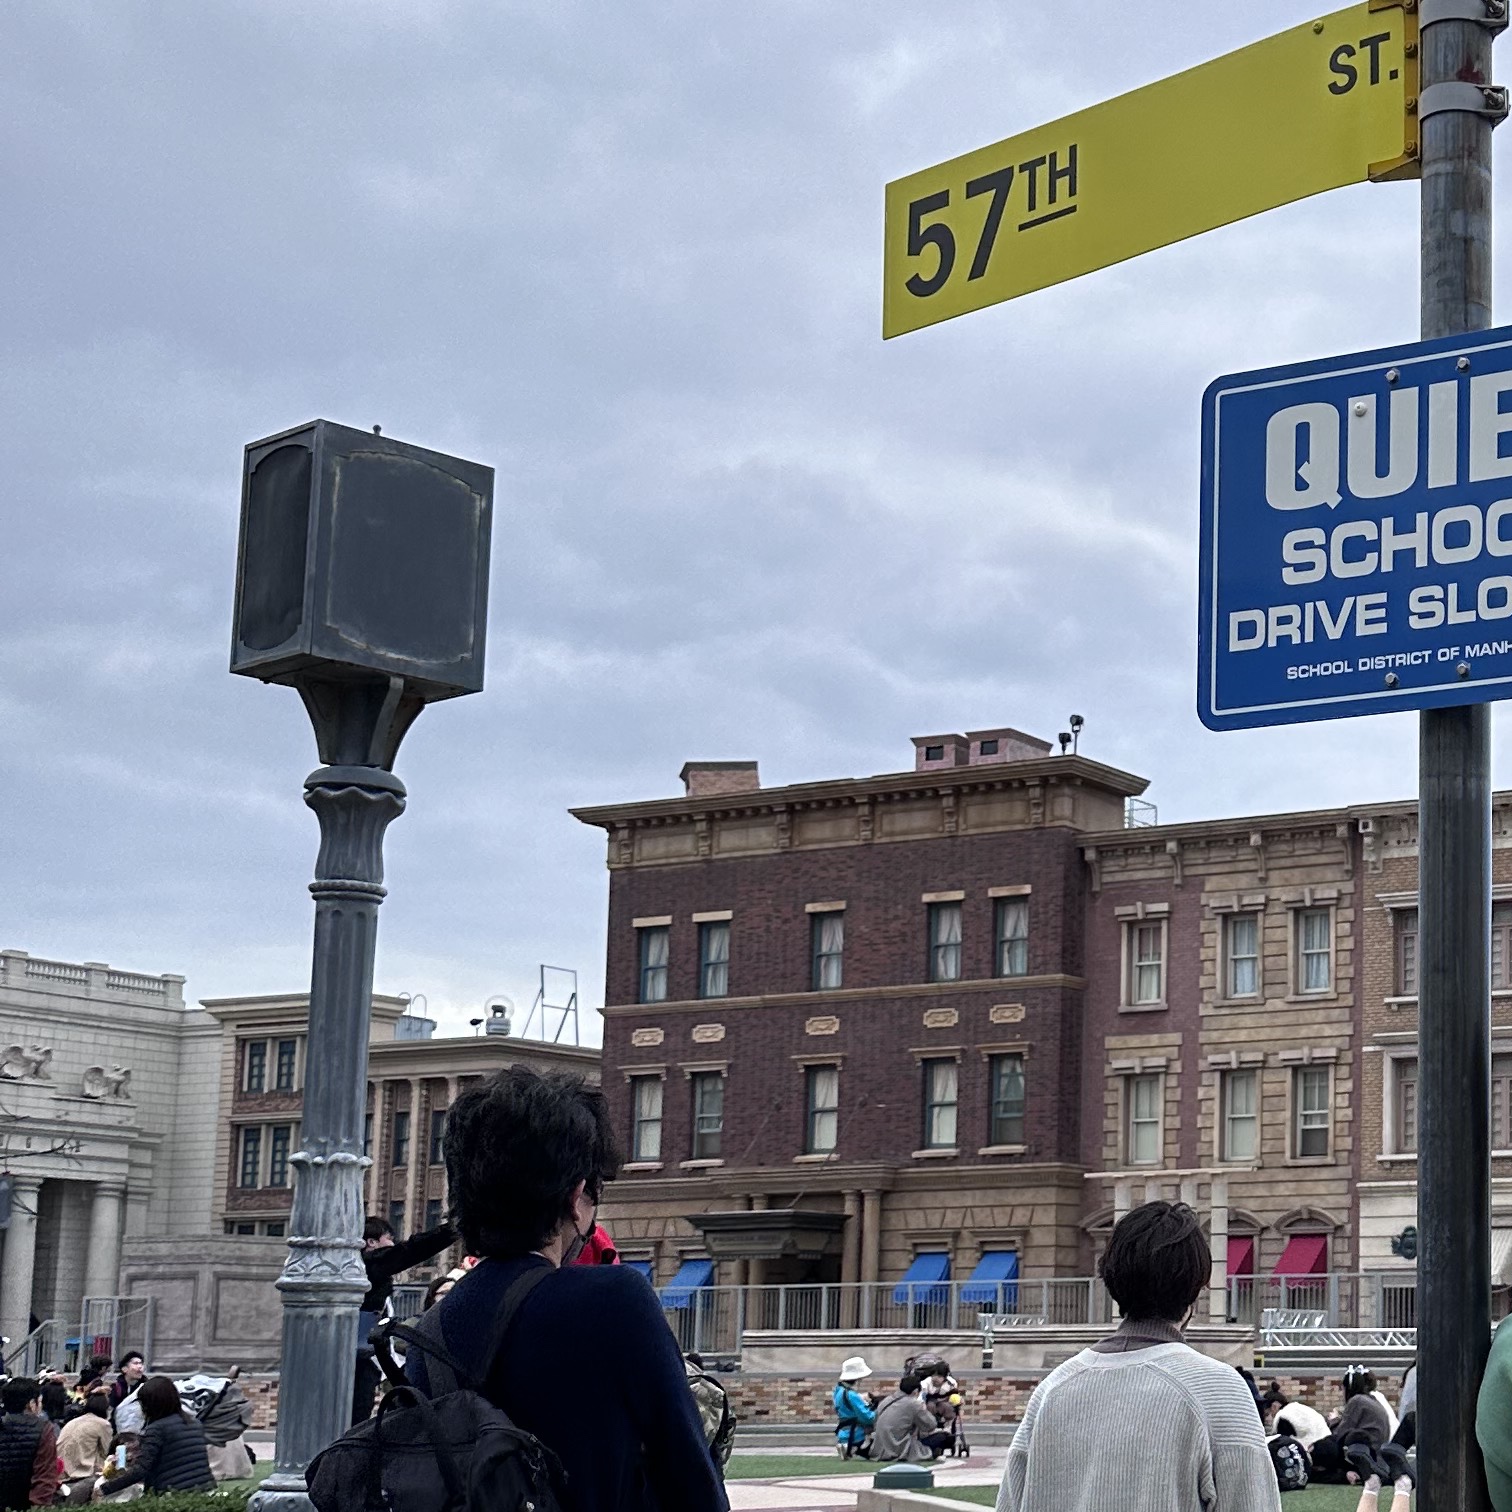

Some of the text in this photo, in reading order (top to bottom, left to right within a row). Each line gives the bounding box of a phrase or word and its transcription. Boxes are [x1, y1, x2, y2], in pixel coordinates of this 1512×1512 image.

[904, 31, 1399, 298] 57TH ST.
[1228, 591, 1389, 653] DRIVE
[1286, 661, 1354, 680] SCHOOL
[1358, 649, 1433, 672] DISTRICT
[1437, 646, 1461, 662] OF
